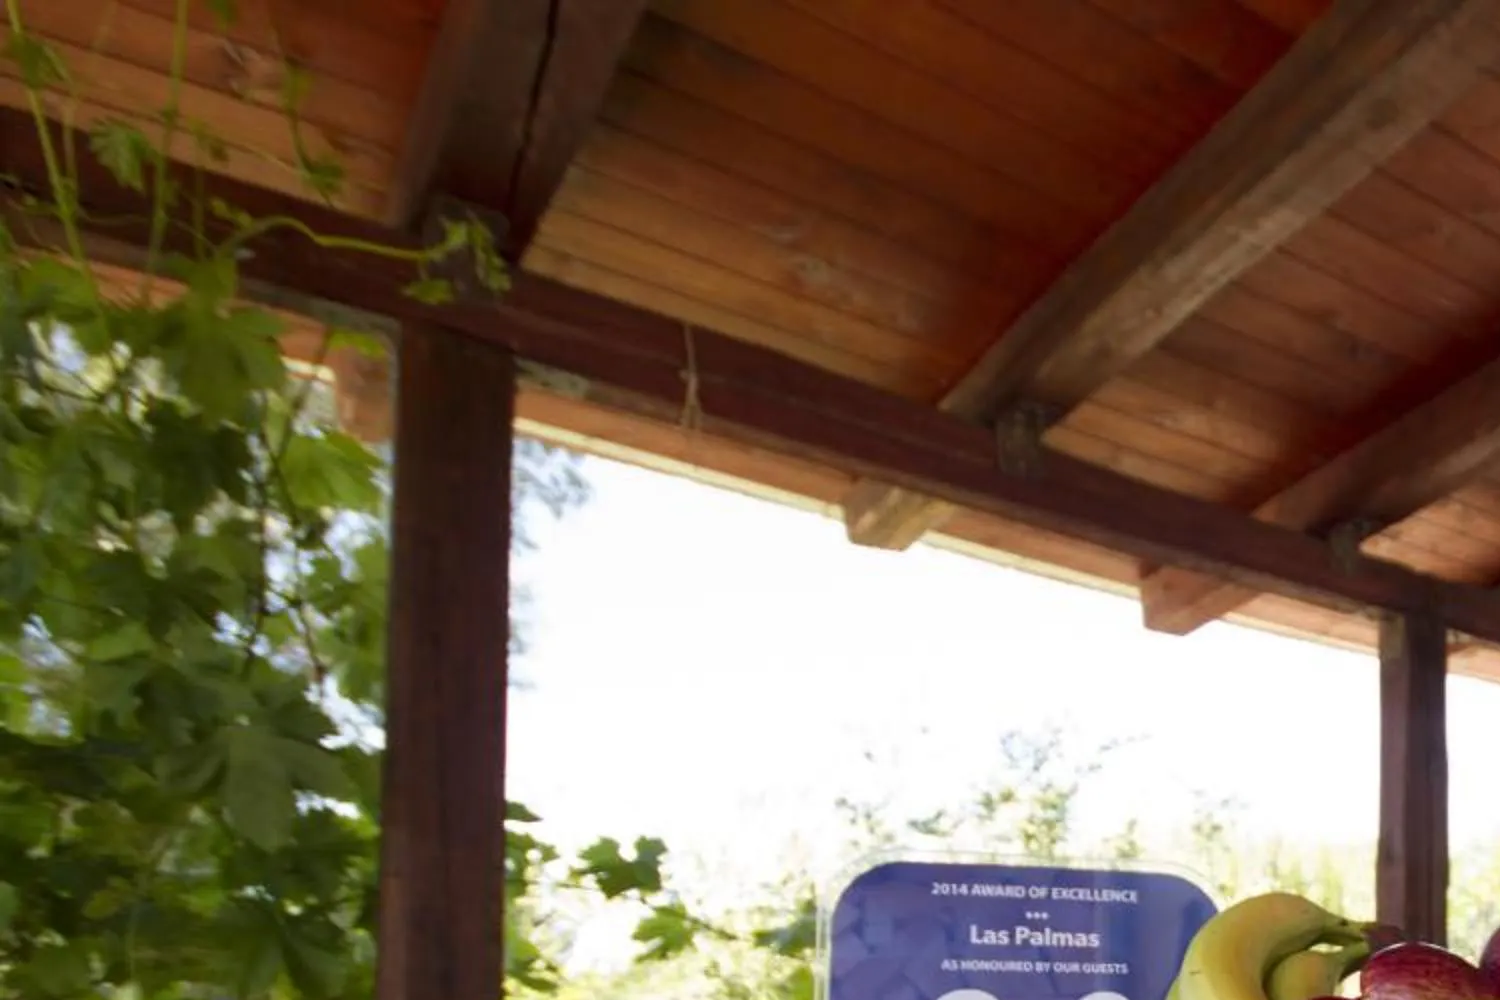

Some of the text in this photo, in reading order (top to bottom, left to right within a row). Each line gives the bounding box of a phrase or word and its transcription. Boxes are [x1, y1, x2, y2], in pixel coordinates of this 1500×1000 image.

[931, 881, 1138, 904] 2014 AWARD OF EXCELLENCE
[969, 924, 1101, 948] Las Palmas
[941, 959, 1129, 975] AS HONOURED BY OUR GUESTS
